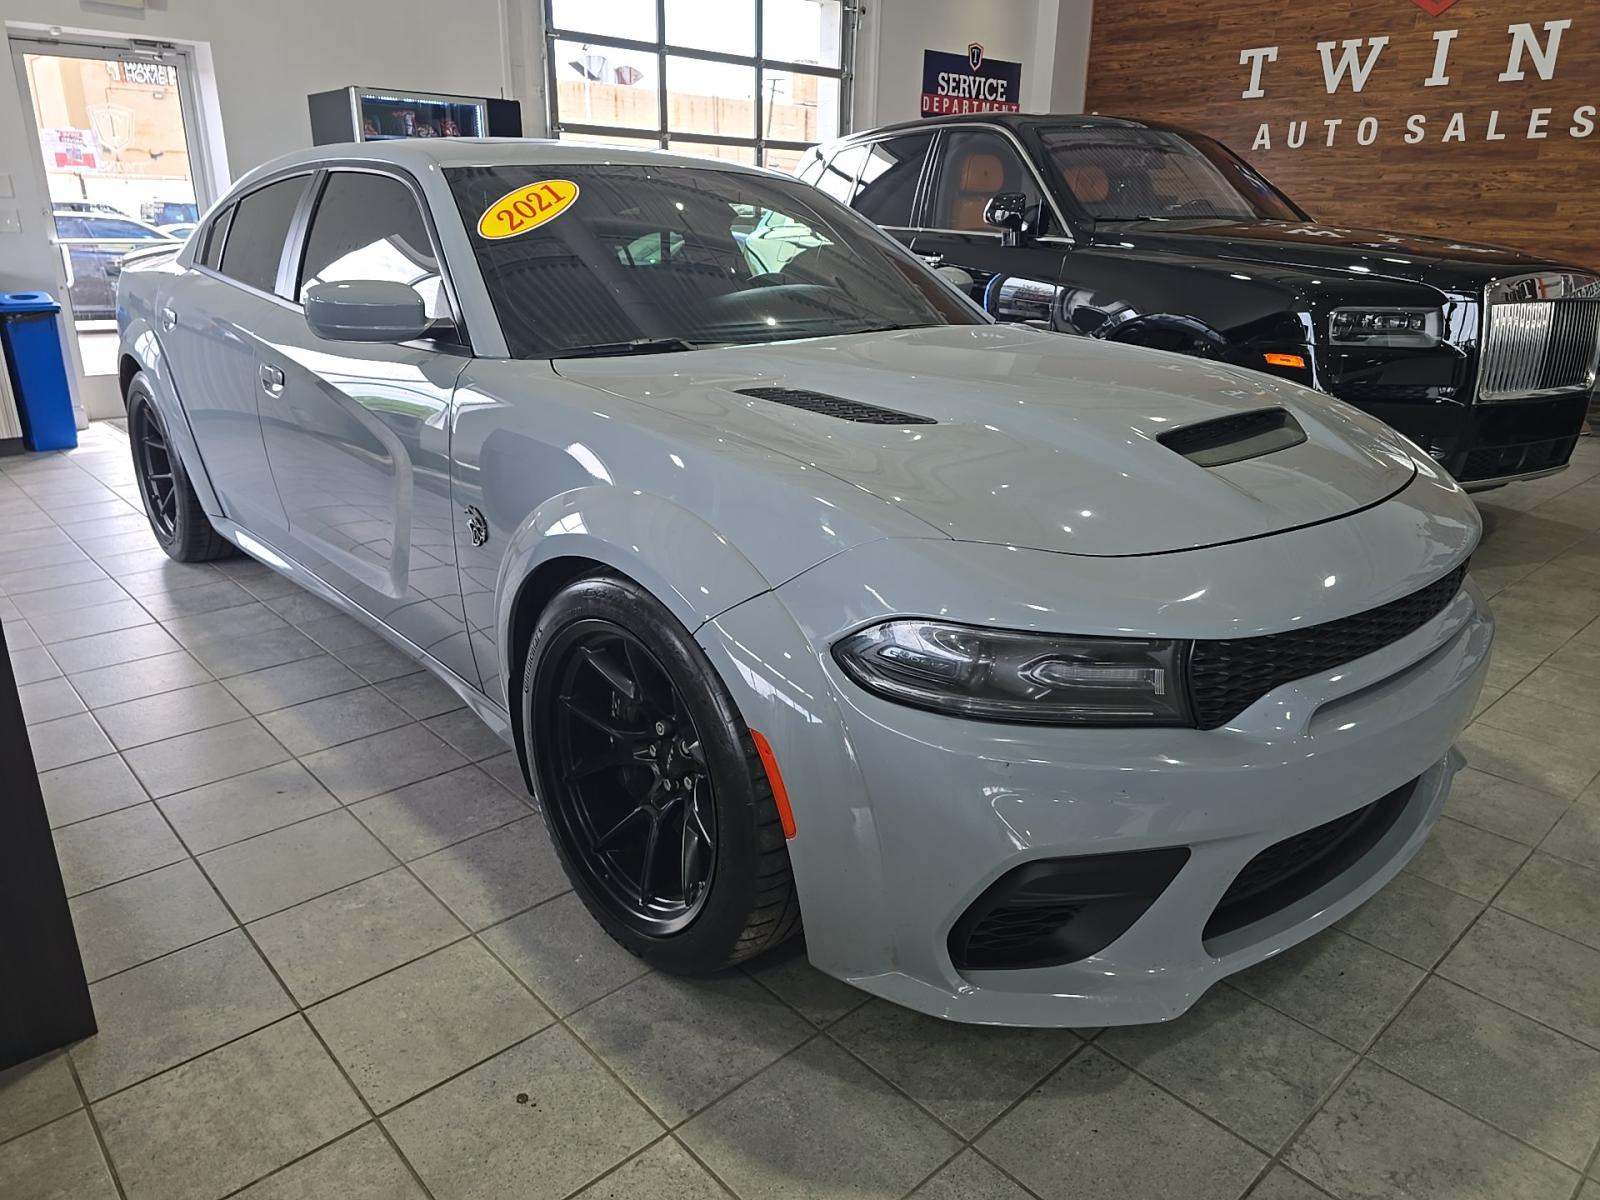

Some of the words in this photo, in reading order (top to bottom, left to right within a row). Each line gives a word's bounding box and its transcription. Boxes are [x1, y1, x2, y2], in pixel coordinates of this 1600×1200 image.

[1238, 17, 1573, 99] TWIN
[937, 71, 1007, 101] SERVICE
[1251, 116, 1379, 150] AUTO
[1403, 105, 1597, 145] SALES
[496, 184, 567, 231] 2021
